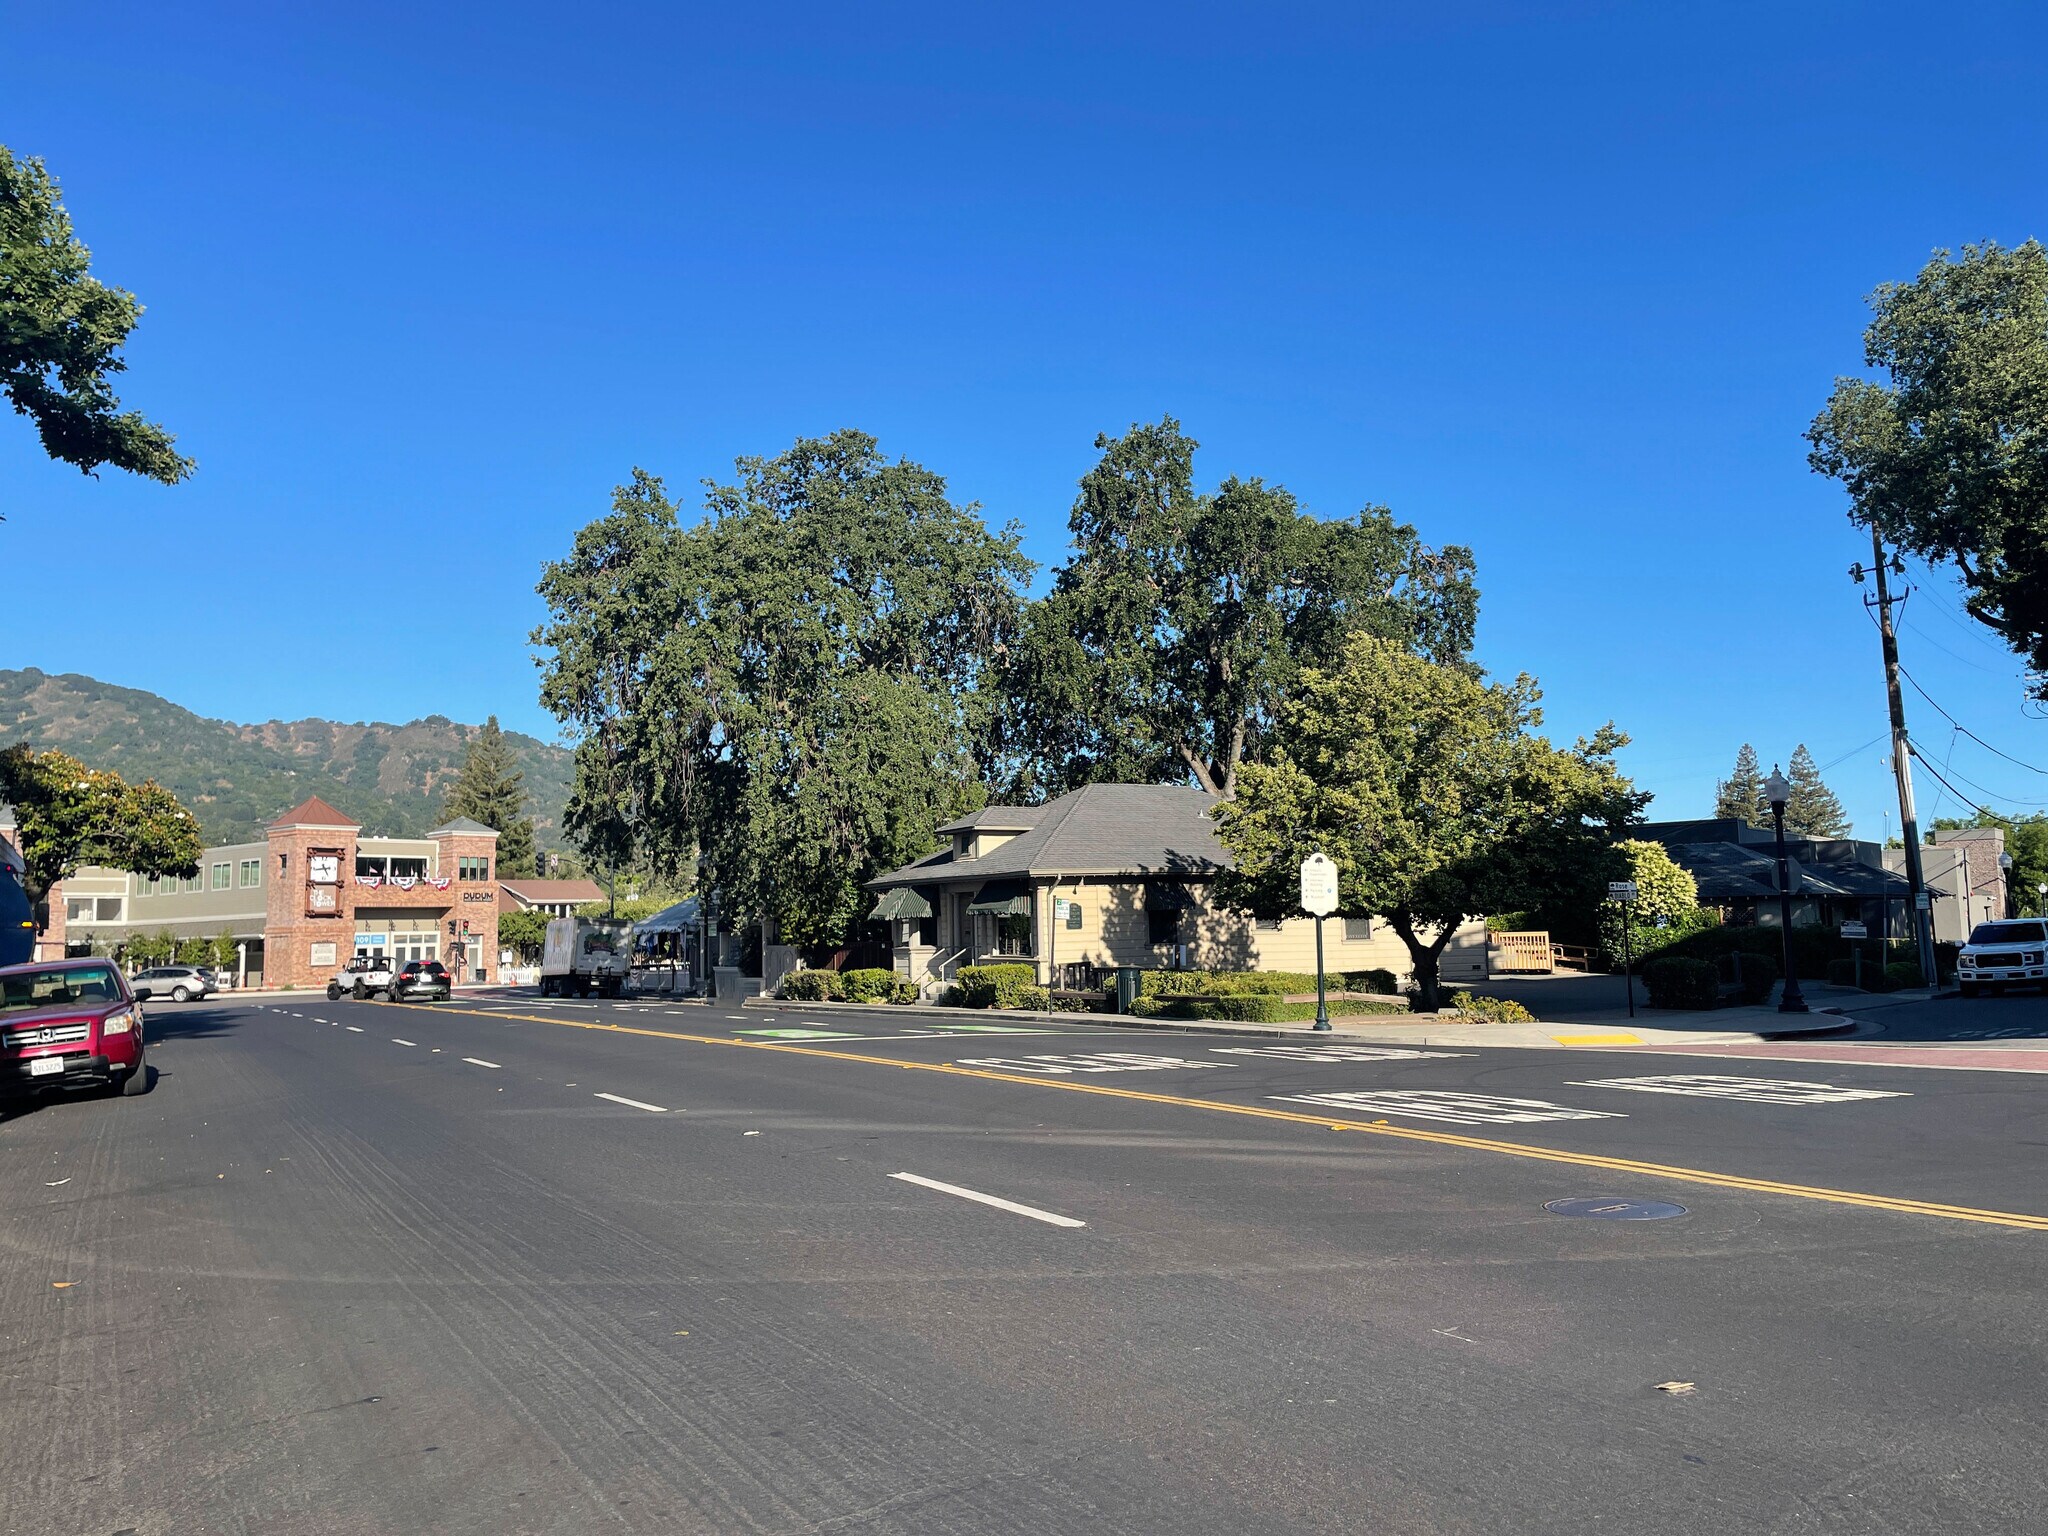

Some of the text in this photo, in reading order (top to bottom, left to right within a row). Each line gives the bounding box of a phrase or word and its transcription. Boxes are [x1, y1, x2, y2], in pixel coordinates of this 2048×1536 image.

[1615, 882, 1628, 890] Rose
[356, 936, 369, 944] 109
[955, 1052, 1239, 1074] CLEAR
